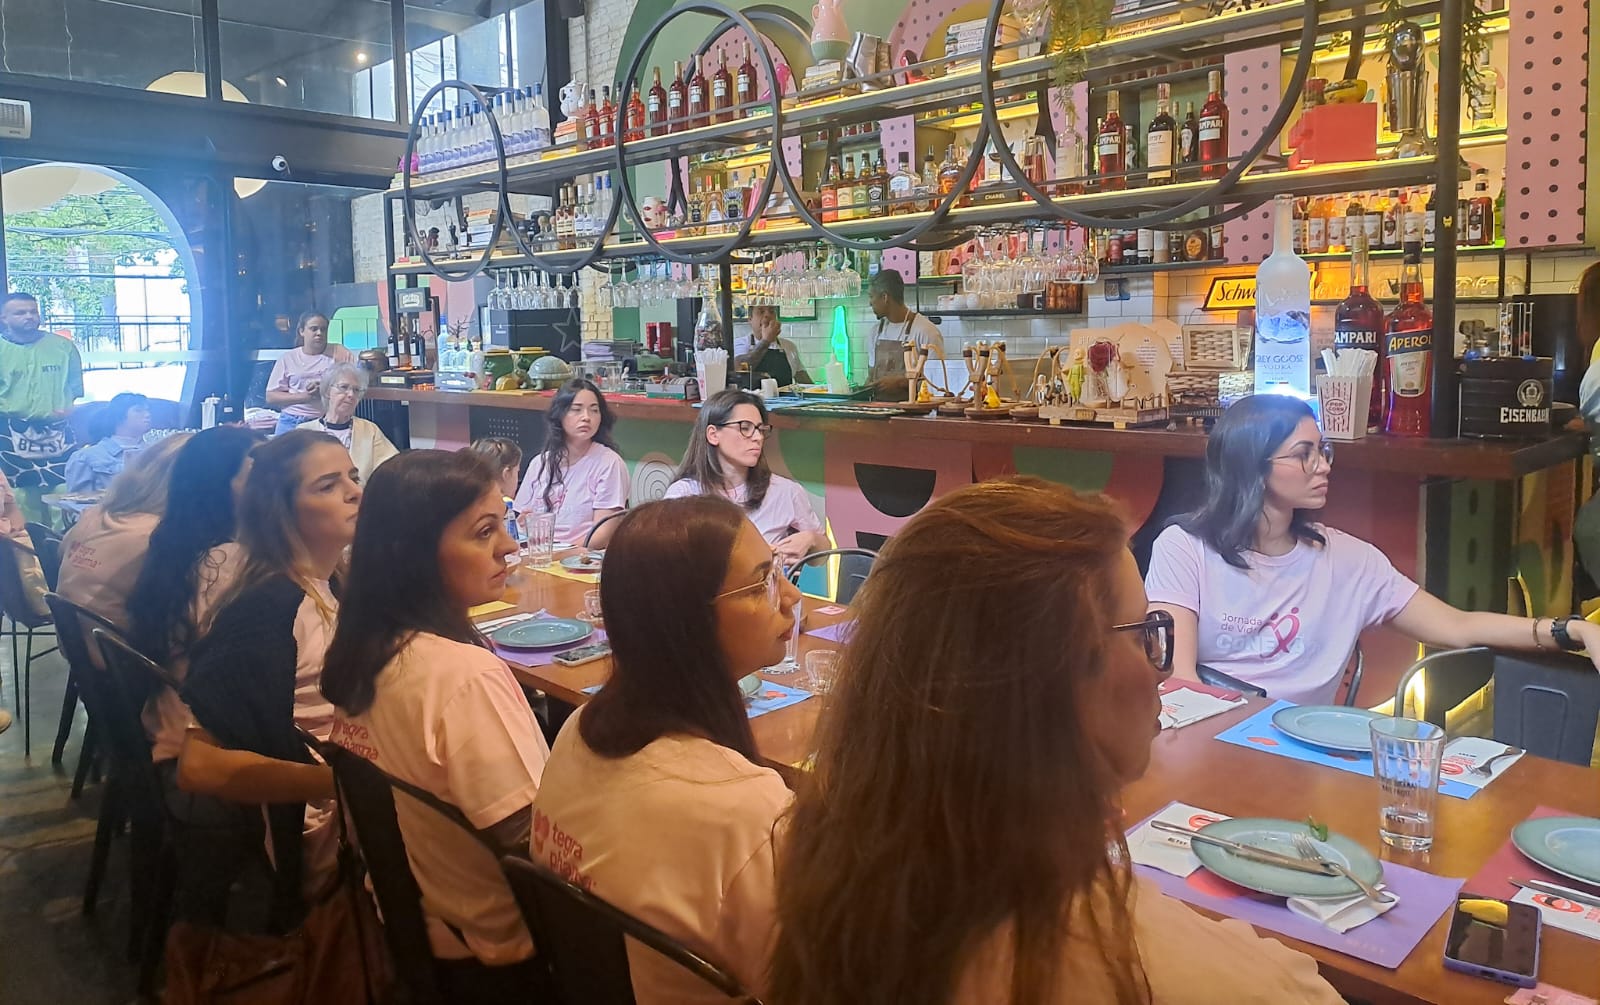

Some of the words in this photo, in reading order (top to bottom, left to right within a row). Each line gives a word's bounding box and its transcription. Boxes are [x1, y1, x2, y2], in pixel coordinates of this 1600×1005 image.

[1334, 331, 1377, 344] AMPARI
[1273, 354, 1304, 363] GOOSE
[19, 438, 64, 453] BETSY
[1223, 613, 1262, 626] Jornada
[1221, 623, 1234, 632] de
[552, 821, 583, 860] tegra
